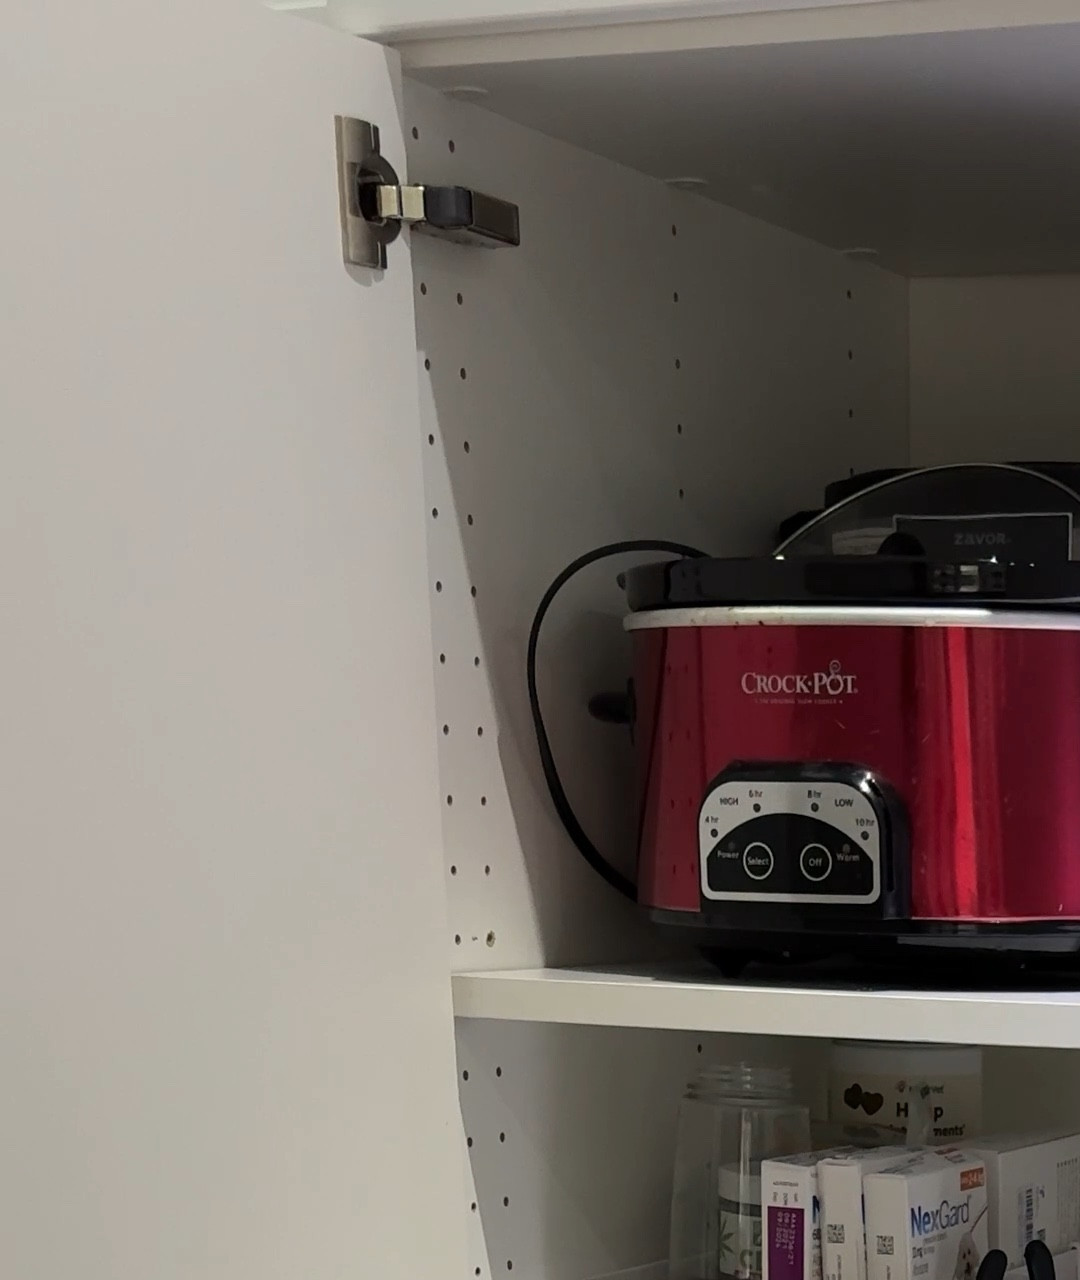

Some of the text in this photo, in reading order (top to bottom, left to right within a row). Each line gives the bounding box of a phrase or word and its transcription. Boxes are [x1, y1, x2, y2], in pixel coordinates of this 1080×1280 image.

[754, 790, 763, 798] hr
[813, 790, 822, 799] hr
[719, 797, 739, 806] HIGH
[834, 799, 854, 808] LOW
[710, 816, 719, 824] hr
[855, 818, 875, 828] 10 hr
[717, 850, 740, 860] Power
[836, 852, 860, 863] Warm
[747, 856, 769, 866] Select
[808, 857, 823, 867] Off
[895, 1102, 944, 1123] Hp
[910, 1196, 971, 1239] NexGard
